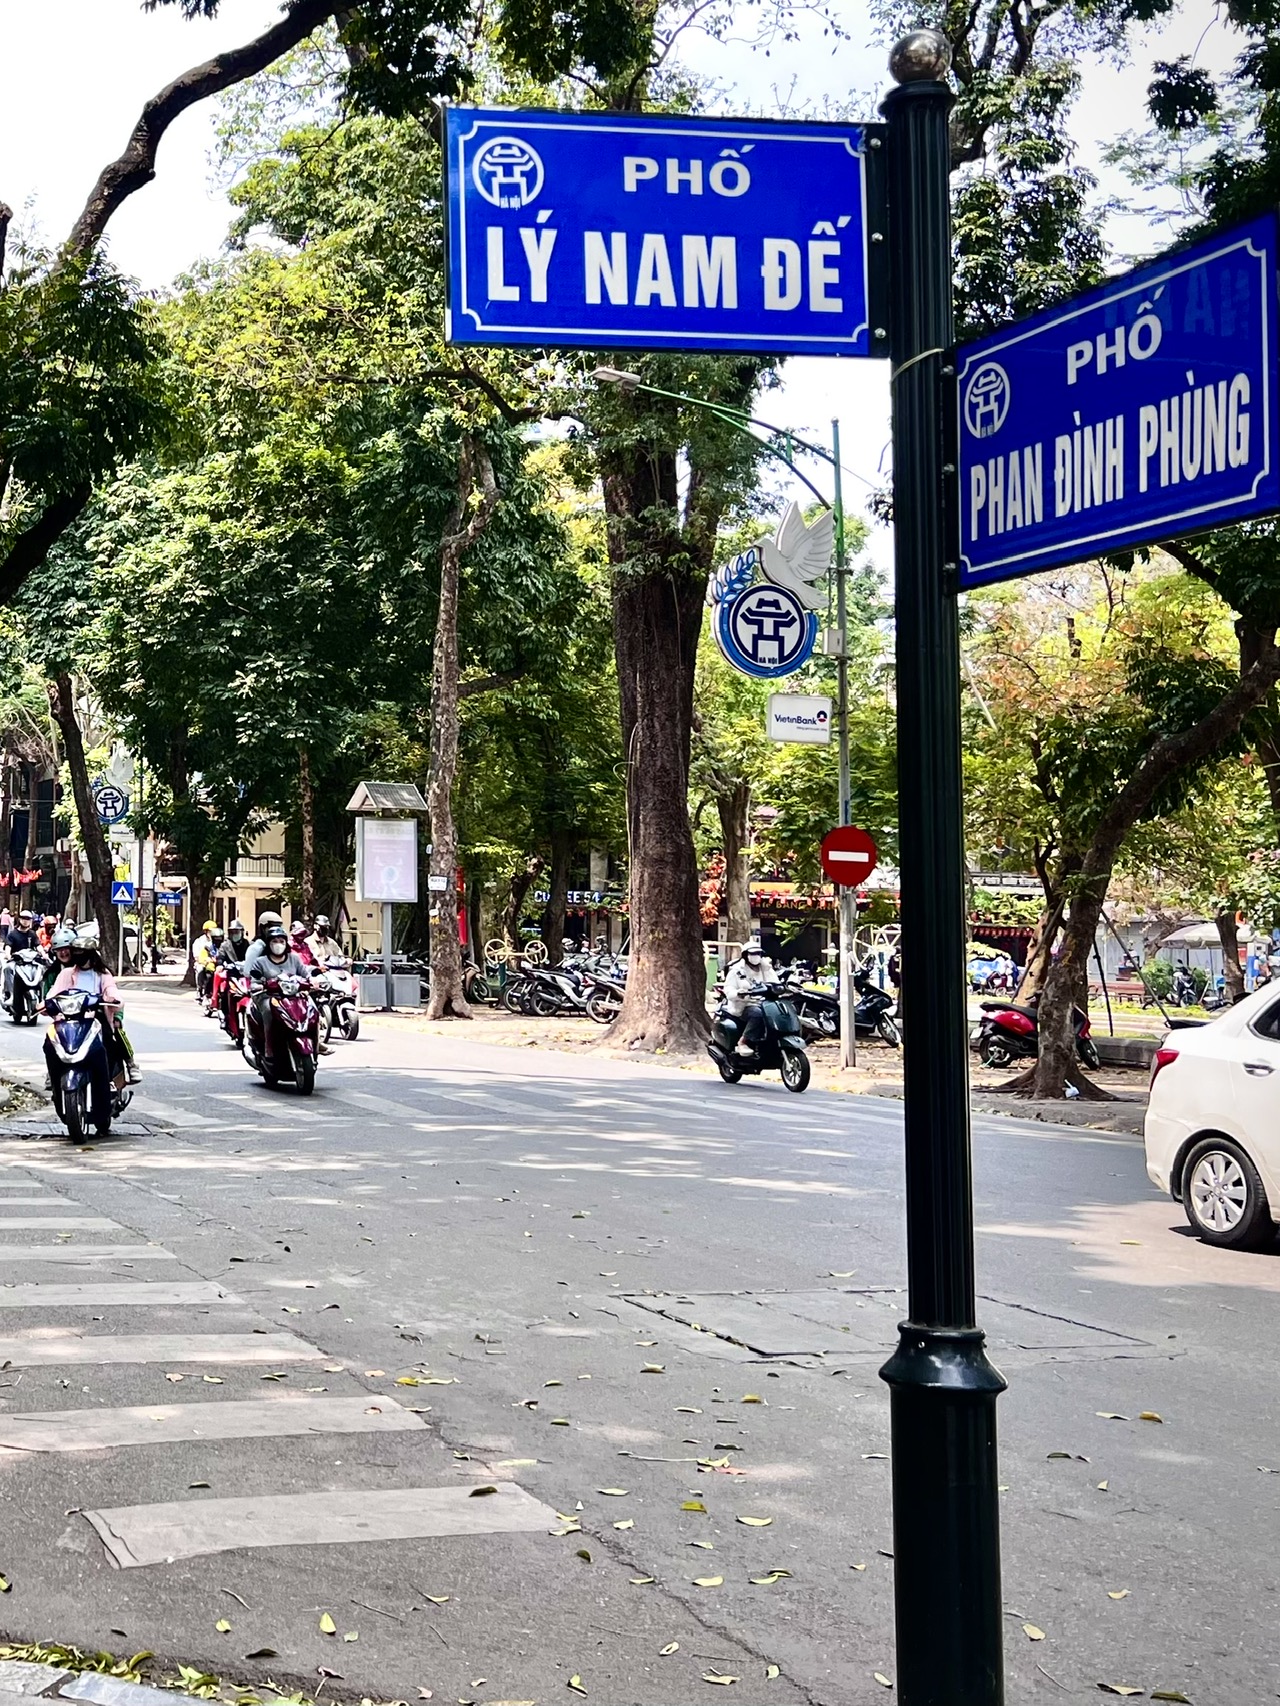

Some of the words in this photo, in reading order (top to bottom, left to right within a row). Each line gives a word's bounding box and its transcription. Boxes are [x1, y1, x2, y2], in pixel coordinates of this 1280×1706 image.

[623, 144, 756, 197] PHỐ
[487, 210, 558, 303] LÝ
[584, 231, 738, 309] NAM
[761, 215, 852, 313] ĐẾ
[1066, 284, 1165, 385] PHỐ
[970, 442, 1043, 542] PHAN
[1054, 410, 1124, 518] ĐÌNH
[1139, 370, 1250, 493] PHÙNG
[774, 713, 817, 726] VietinBank
[583, 891, 600, 904] 54
